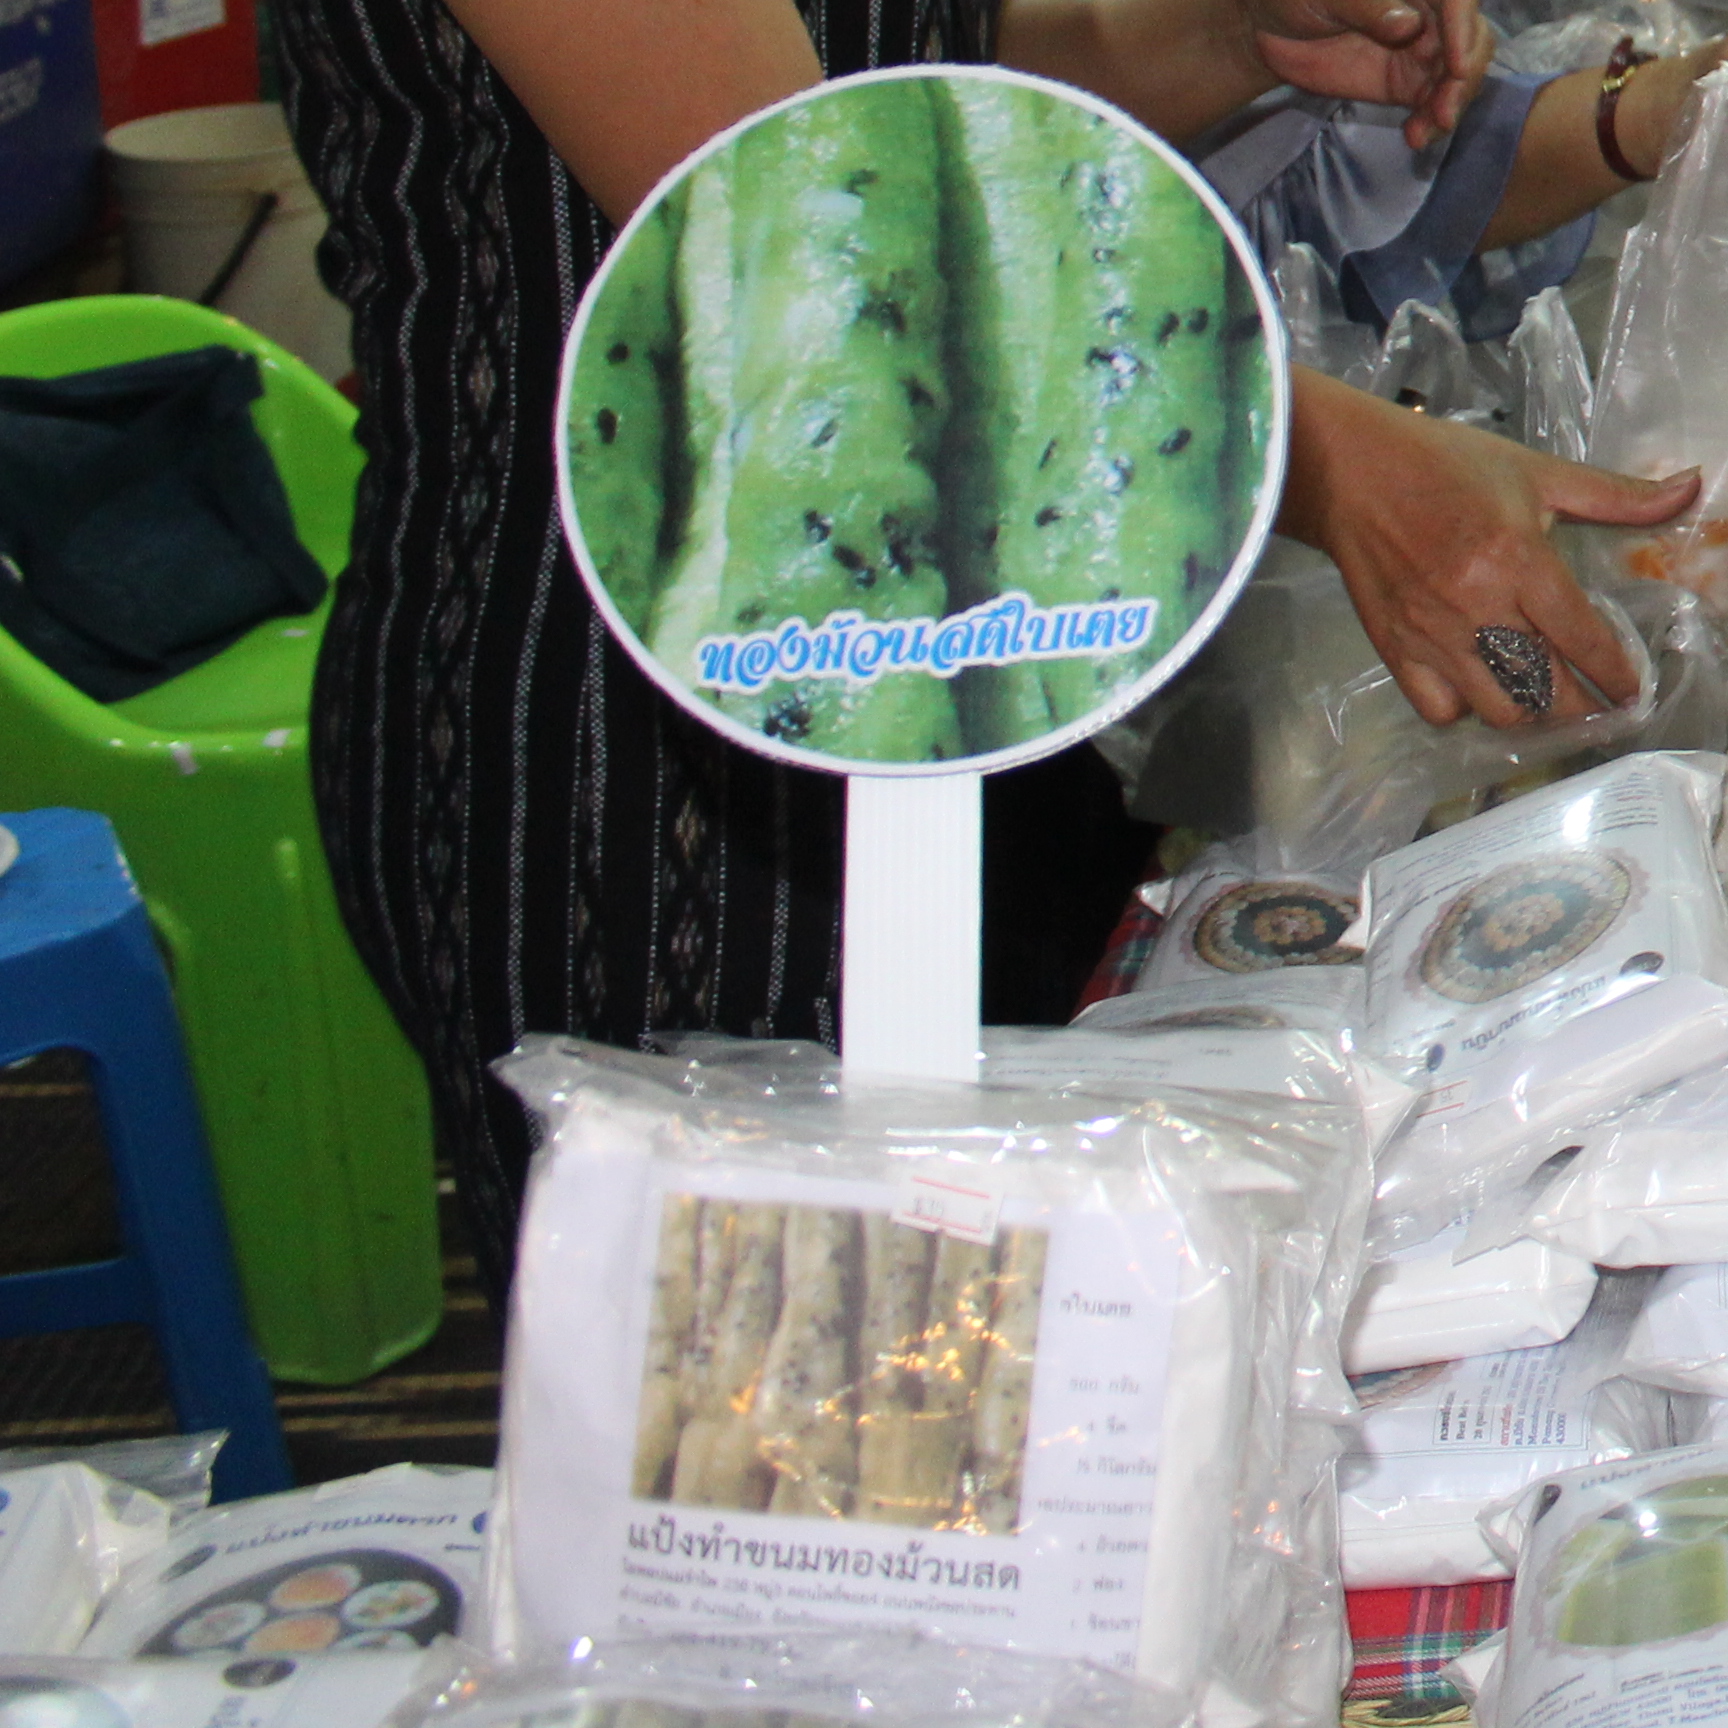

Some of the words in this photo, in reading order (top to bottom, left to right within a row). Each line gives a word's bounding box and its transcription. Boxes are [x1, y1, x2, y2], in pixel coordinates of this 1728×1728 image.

[699, 598, 1151, 688] ทองม้วนสดใบเตย
[627, 1512, 1022, 1592] แป้งทำขนมทองม้วนสด
